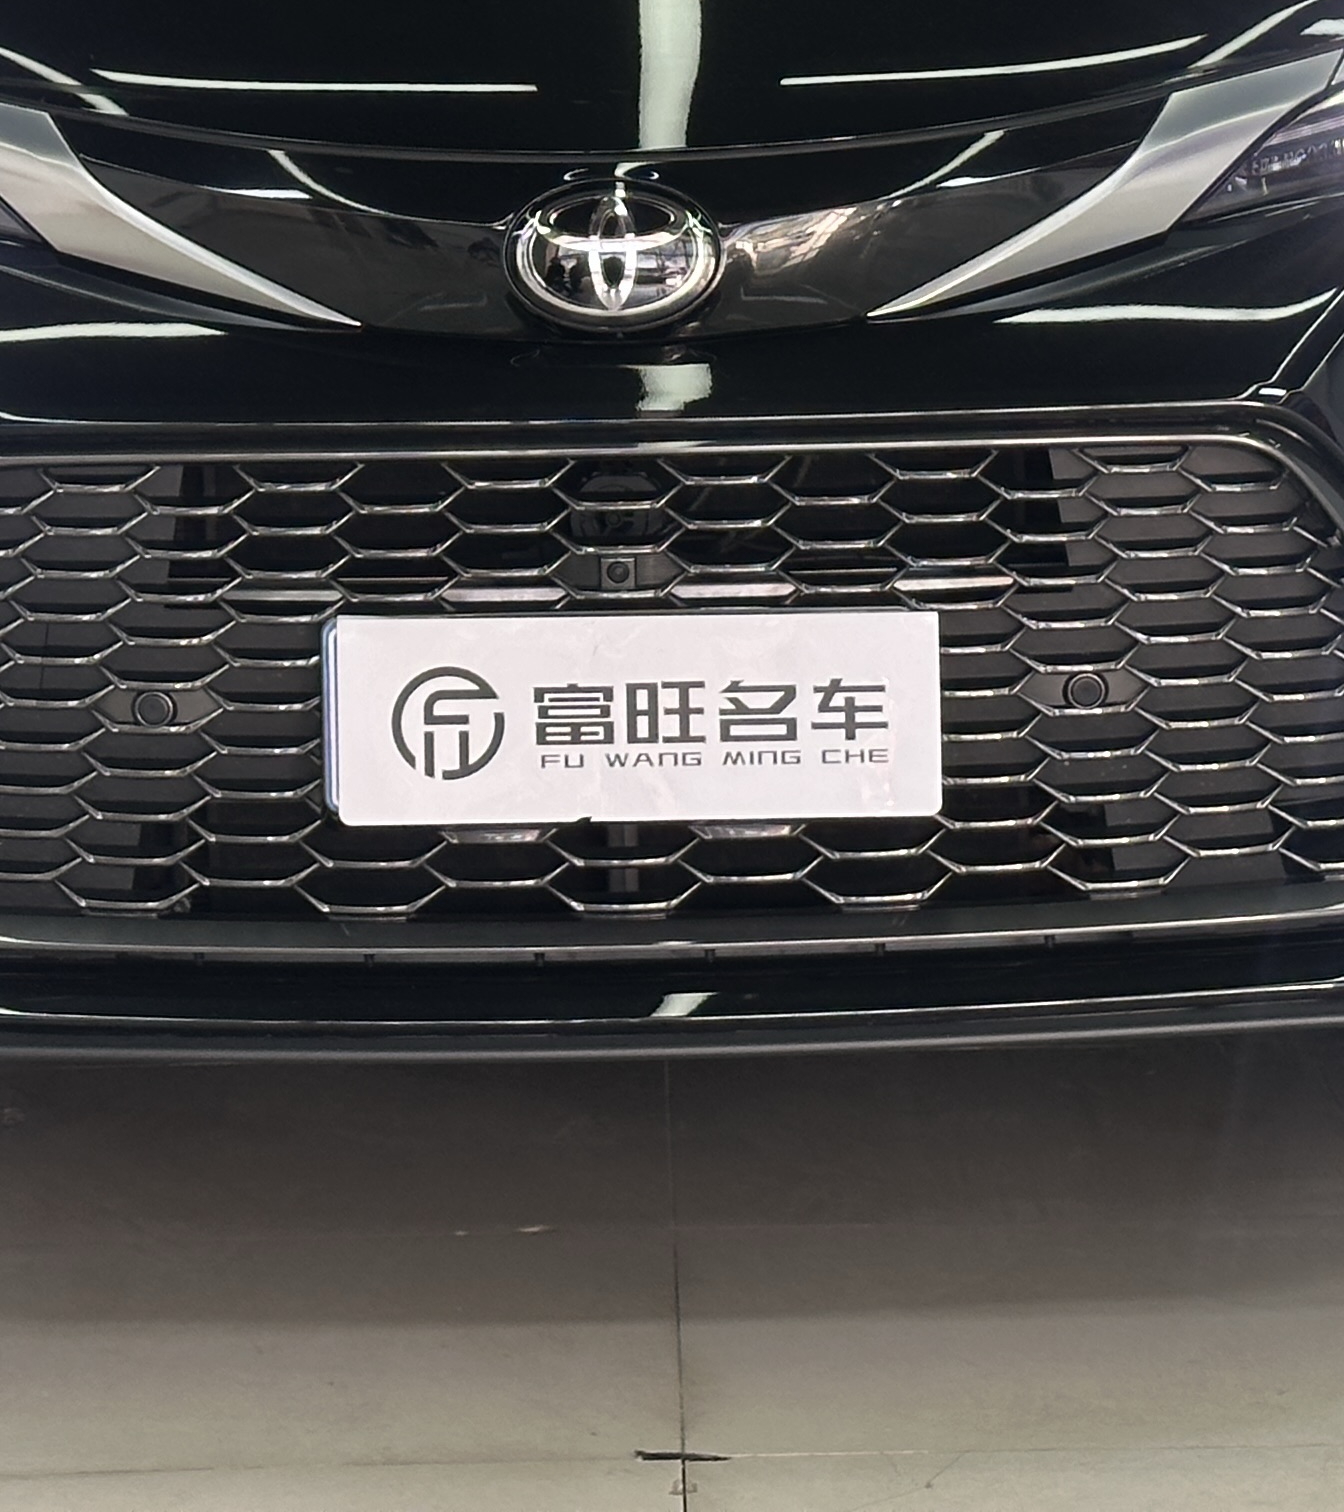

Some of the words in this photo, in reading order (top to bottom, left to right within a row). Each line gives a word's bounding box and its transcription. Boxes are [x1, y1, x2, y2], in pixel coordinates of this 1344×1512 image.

[533, 678, 889, 746] 富旺名车
[540, 753, 585, 769] FU
[604, 751, 703, 768] WANG
[722, 749, 802, 767] MING
[820, 748, 889, 765] CHE
